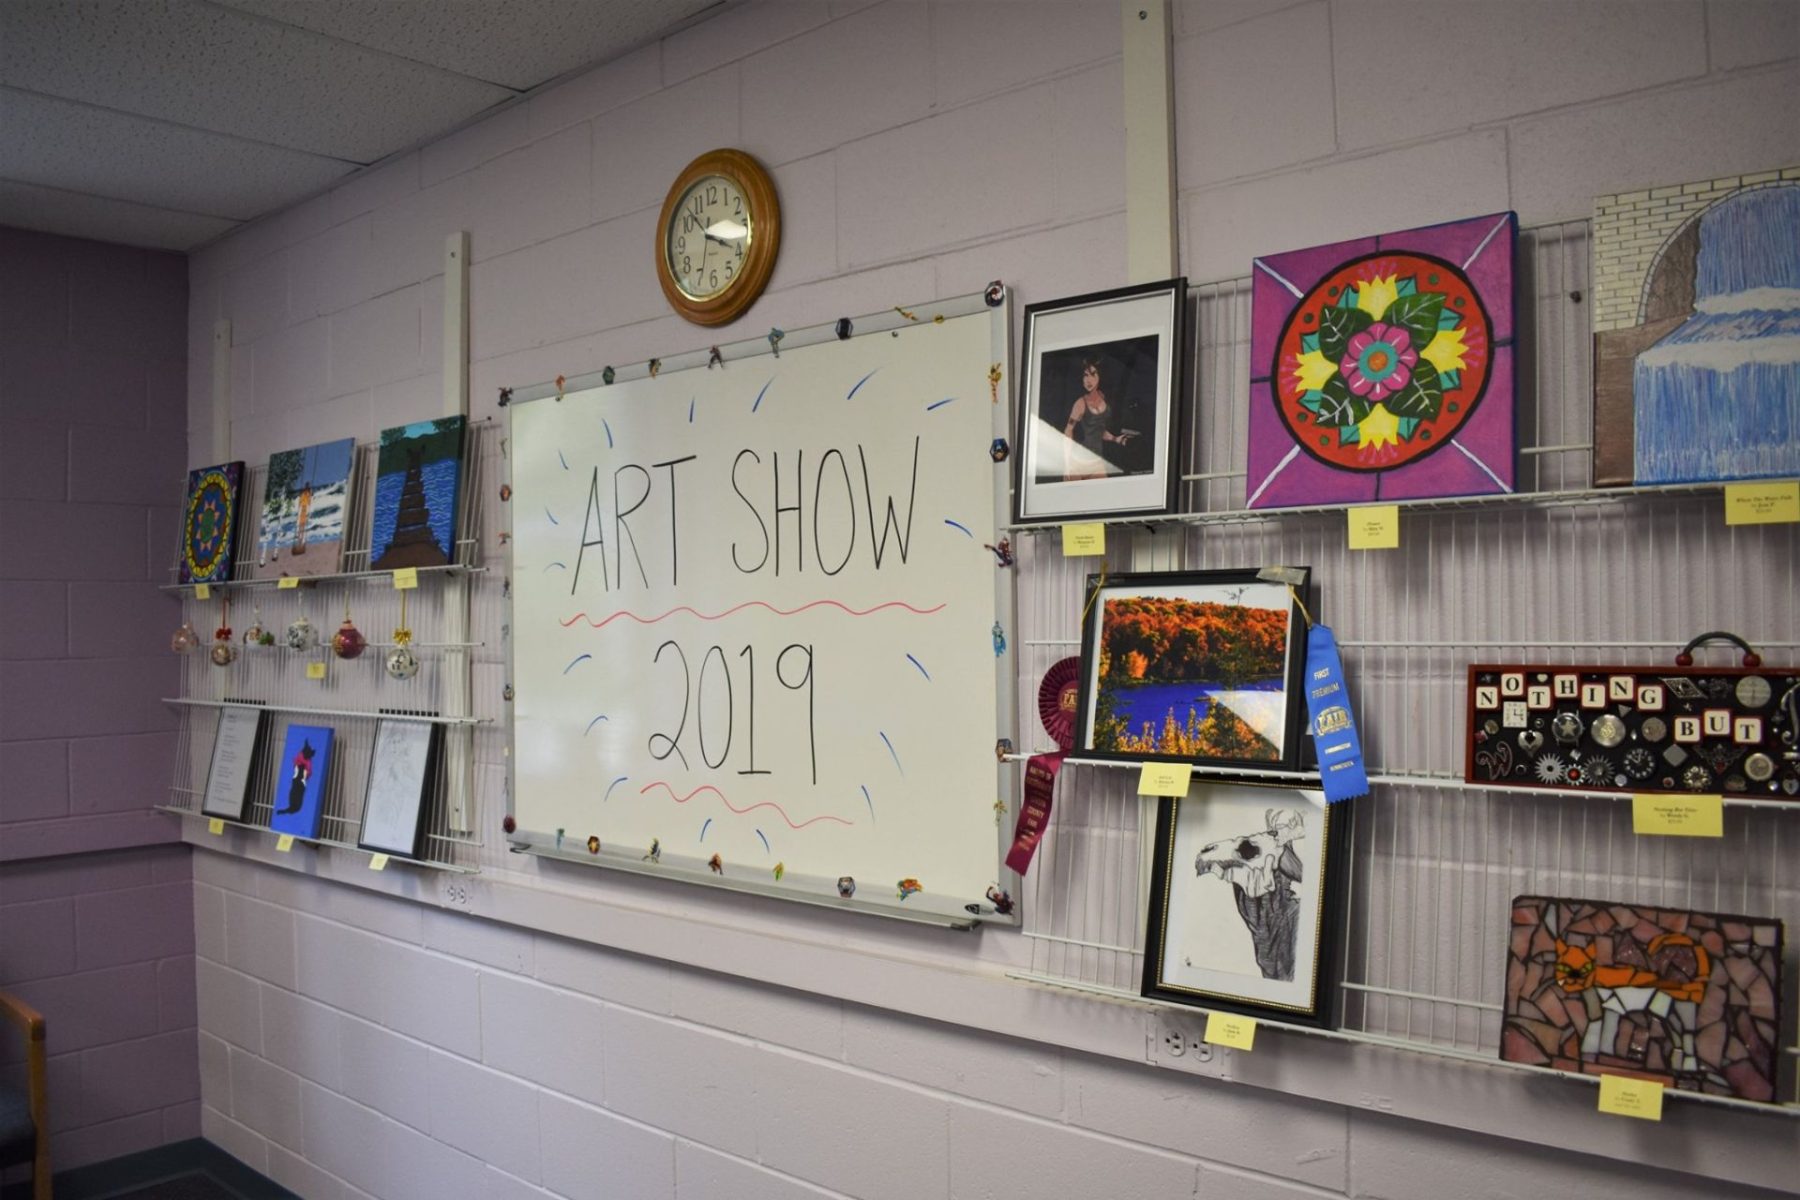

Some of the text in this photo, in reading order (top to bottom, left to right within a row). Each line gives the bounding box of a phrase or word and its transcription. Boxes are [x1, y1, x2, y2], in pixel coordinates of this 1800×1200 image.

[694, 195, 704, 215] 11
[706, 186, 718, 207] 12
[723, 187, 729, 207] 1
[733, 196, 742, 216] 2
[683, 214, 694, 234] 10
[678, 236, 686, 255] 9
[735, 241, 743, 261] 4
[683, 255, 691, 275] 8
[725, 261, 733, 280] 5
[696, 268, 704, 287] 7
[710, 269, 718, 288] 6
[571, 435, 920, 596] ART SHOW
[1313, 668, 1330, 680] FIRST
[1312, 682, 1340, 699] PREMIUM
[1479, 676, 1657, 706] NOTHING
[648, 640, 816, 785] 2019
[1679, 715, 1756, 740] BUT
